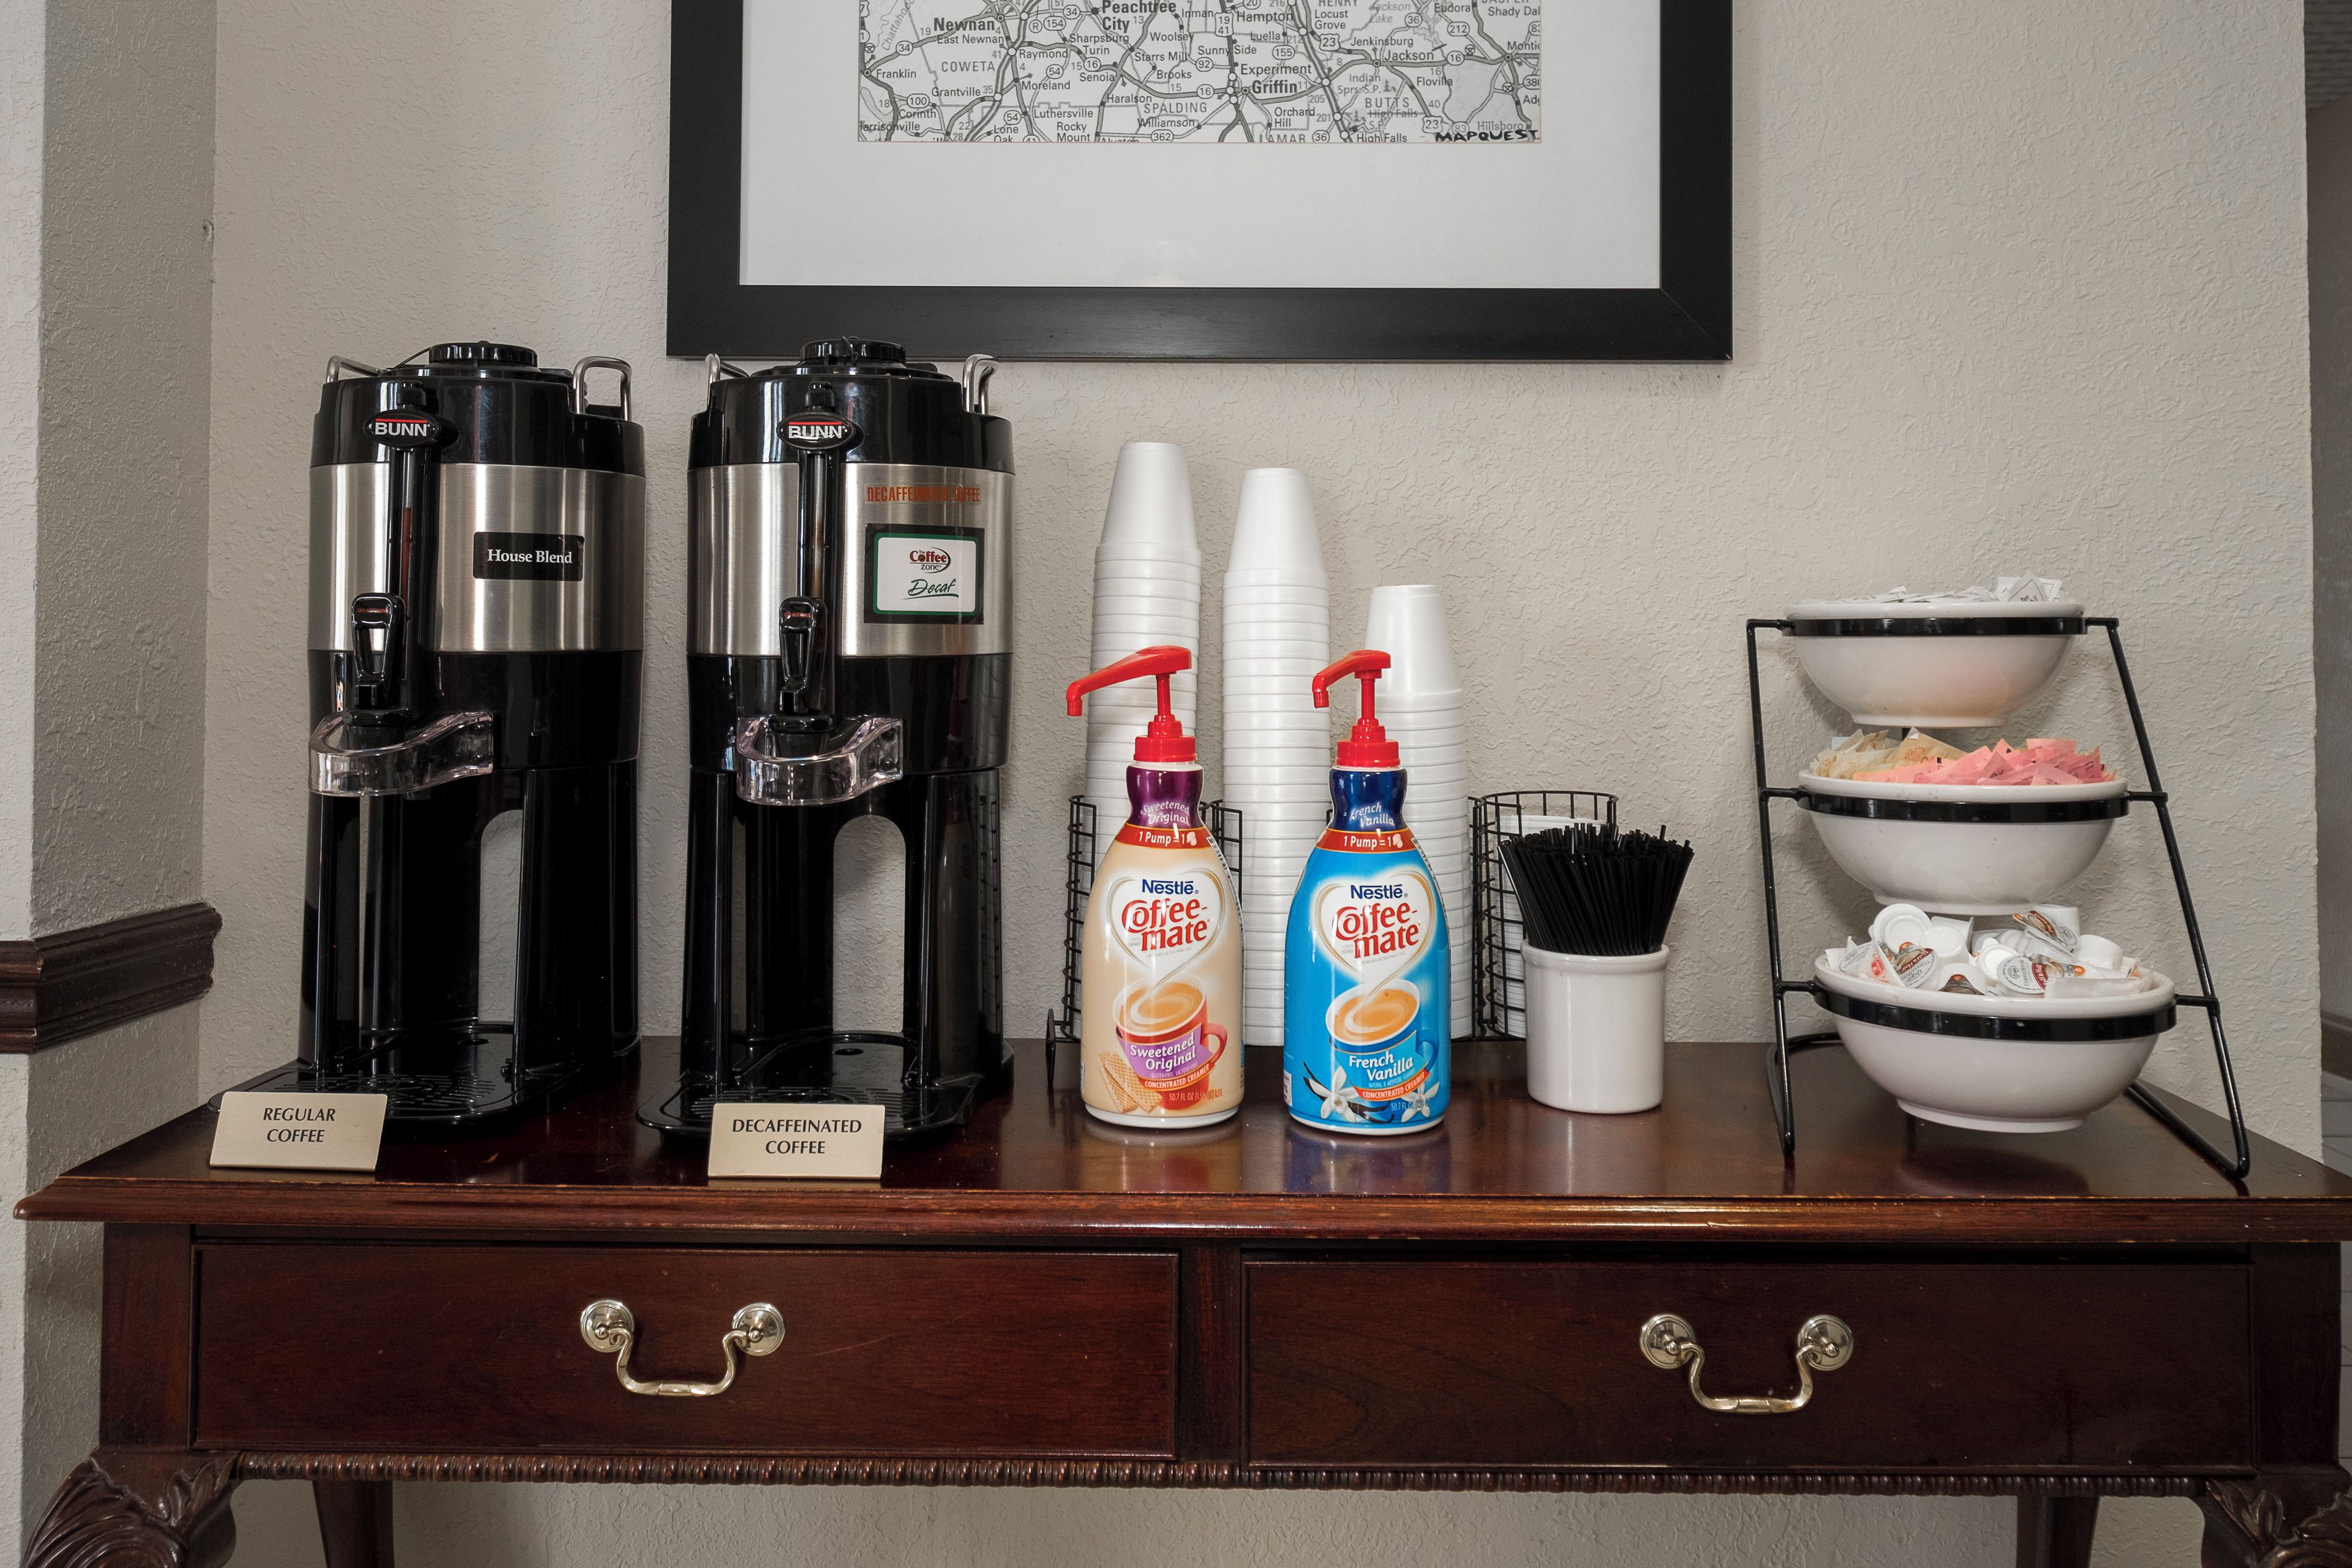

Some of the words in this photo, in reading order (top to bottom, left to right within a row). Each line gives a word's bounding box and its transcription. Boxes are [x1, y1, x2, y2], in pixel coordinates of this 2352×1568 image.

[1102, 1, 1176, 13] Peachtree
[1370, 2, 1411, 11] Jackson
[1434, 4, 1471, 13] Eudora
[1182, 9, 1214, 18] Inman
[1237, 10, 1293, 22] Hampton
[1314, 9, 1348, 18] Locust
[1488, 7, 1520, 18] Shady
[1370, 15, 1393, 23] Lake
[934, 18, 995, 31] Newnan
[1102, 17, 1130, 32] City
[937, 35, 958, 44] East
[962, 34, 1004, 43] Newnan
[1069, 34, 1129, 44] Sharpsburg
[1150, 32, 1193, 43] Woolsey
[1251, 31, 1281, 40] Luella
[1351, 37, 1414, 47] Jenkinsburg
[899, 43, 910, 52] 34
[1083, 46, 1109, 55] Turin
[1198, 46, 1230, 57] Sunny
[1234, 45, 1257, 55] Side
[992, 50, 1001, 59] 41
[1020, 50, 1068, 60] Raymond
[1135, 53, 1165, 62] Starrs
[1169, 51, 1187, 61] Mill
[1384, 50, 1434, 61] Jackson
[941, 61, 995, 72] COWETA
[1336, 58, 1343, 66] 8
[876, 69, 916, 78] Franklin
[1157, 70, 1192, 79] Brooks
[1241, 64, 1312, 77] Experiment
[1430, 67, 1441, 76] 16
[1080, 73, 1115, 82] Senoia
[1349, 74, 1381, 83] Indian
[1417, 77, 1453, 86] Flovilla
[982, 85, 993, 94] 35
[1022, 81, 1071, 90] Moreland
[1252, 80, 1297, 94] Griffin
[1338, 85, 1362, 96] Sprs.
[932, 87, 981, 97] Grantville
[880, 99, 890, 108] 18
[1107, 94, 1152, 103] Haralson
[1309, 94, 1325, 103] 205
[1365, 97, 1409, 108] BUTTS
[1144, 102, 1207, 113] SPALDING
[1428, 100, 1440, 108] 40
[899, 109, 937, 119] Corinth
[1035, 110, 1093, 118] Luthersville
[1275, 107, 1315, 116] Orchard
[1369, 110, 1393, 119] High
[1396, 109, 1418, 118] Falls
[1137, 118, 1194, 127] Williamson
[1275, 118, 1291, 127] Hill
[1317, 113, 1331, 122] 201
[959, 122, 970, 130] 22
[994, 125, 1019, 134] Lone
[1057, 122, 1087, 132] Rocky
[1425, 120, 1439, 129] 23
[1455, 124, 1466, 133] 83
[1478, 121, 1523, 130] Hillsboro
[1057, 133, 1090, 141] Mount
[1357, 134, 1380, 142] High
[1384, 134, 1408, 142] Falls
[375, 422, 427, 436] BUNN
[788, 426, 842, 439] BUNN
[488, 549, 532, 562] House
[535, 550, 572, 564] Blend
[910, 550, 947, 563] Coffee
[908, 578, 956, 596] Decaf
[1142, 801, 1189, 816] Sweetened
[1350, 802, 1382, 821] French
[1148, 812, 1190, 826] Original
[1360, 813, 1395, 828] Vanilla
[1139, 831, 1143, 842] 1
[1145, 831, 1171, 846] Pump
[1182, 834, 1185, 844] 1
[1344, 835, 1348, 846] 1
[1351, 835, 1378, 851] Pump
[1387, 836, 1392, 847] 1
[1141, 919, 1207, 951] mate
[1354, 923, 1419, 959] mate
[1130, 1032, 1194, 1058] Sweetened
[1145, 1046, 1196, 1072] Original
[1349, 1050, 1395, 1069] French
[1366, 1057, 1414, 1081] Vanilla
[1145, 1078, 1186, 1088] CONCENTRATED
[1187, 1063, 1210, 1083] CREAMER
[1362, 1087, 1404, 1099] CONCENTRATED
[1405, 1072, 1425, 1092] CREAMER
[1169, 1093, 1180, 1101] 50.7
[1180, 1092, 1186, 1101] FL
[1187, 1091, 1194, 1100] OZ
[1391, 1102, 1401, 1111] 50.7
[263, 1107, 336, 1121] REGULAR
[733, 1119, 862, 1133] DECAFFEINATED
[266, 1129, 325, 1142] COFFEE
[766, 1140, 826, 1154] COFFEE
